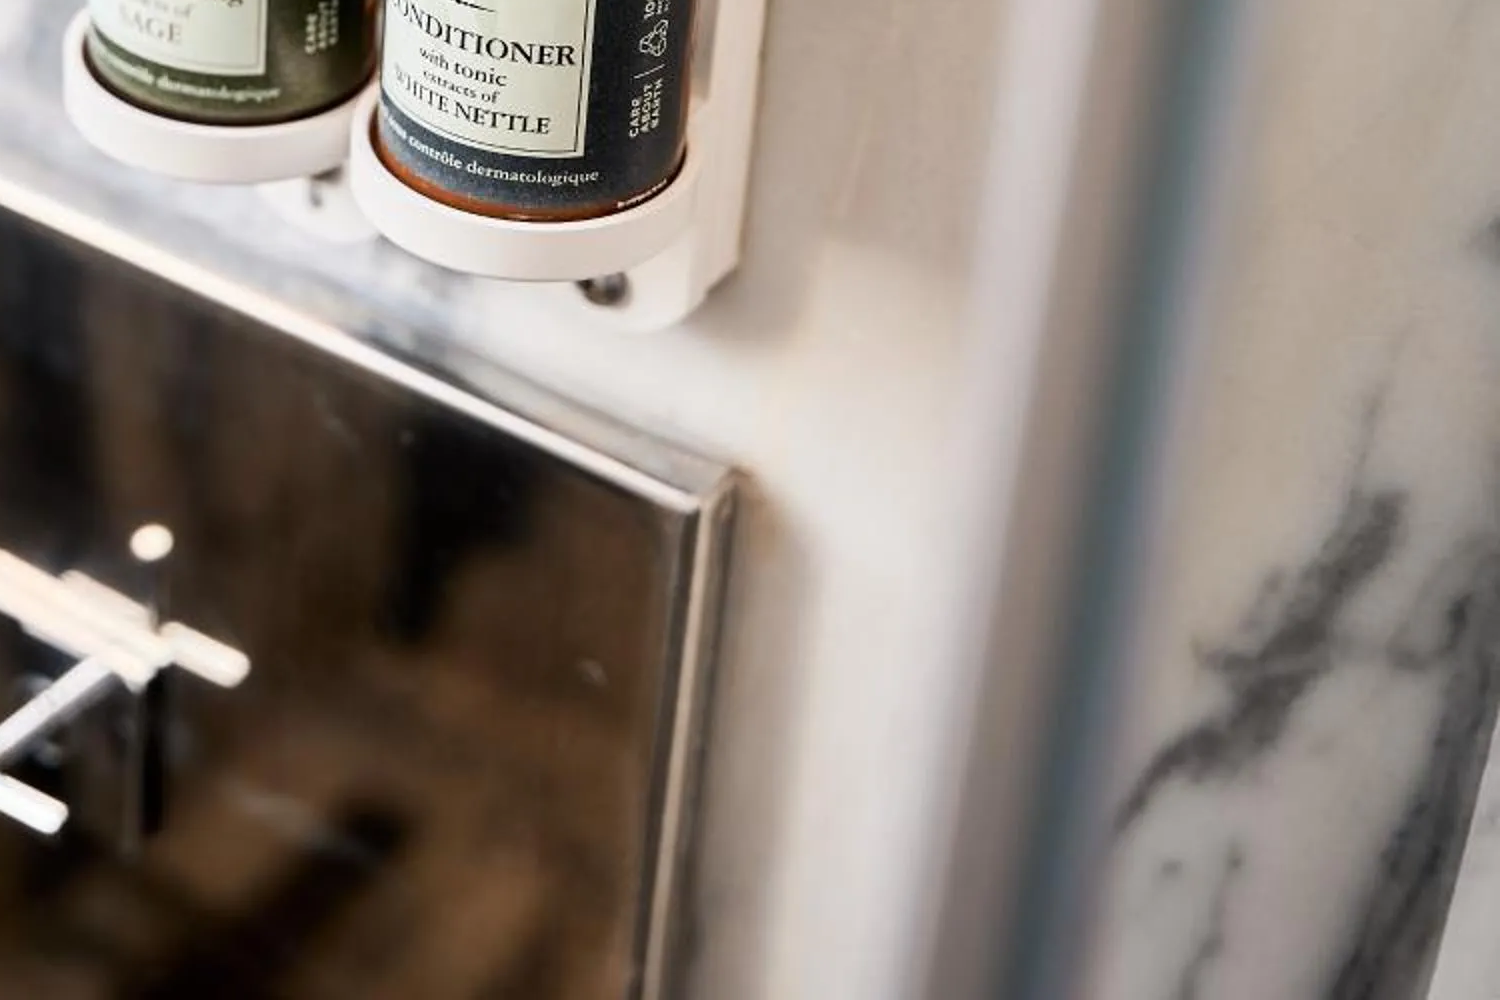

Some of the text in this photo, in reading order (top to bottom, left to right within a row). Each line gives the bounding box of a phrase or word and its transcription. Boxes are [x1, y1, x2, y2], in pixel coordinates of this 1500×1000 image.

[420, 46, 507, 87] with tonic
[423, 71, 500, 104] extracts of
[455, 101, 551, 135] NETTLE
[409, 133, 462, 169] contrôle
[465, 160, 599, 187] dermatologique
